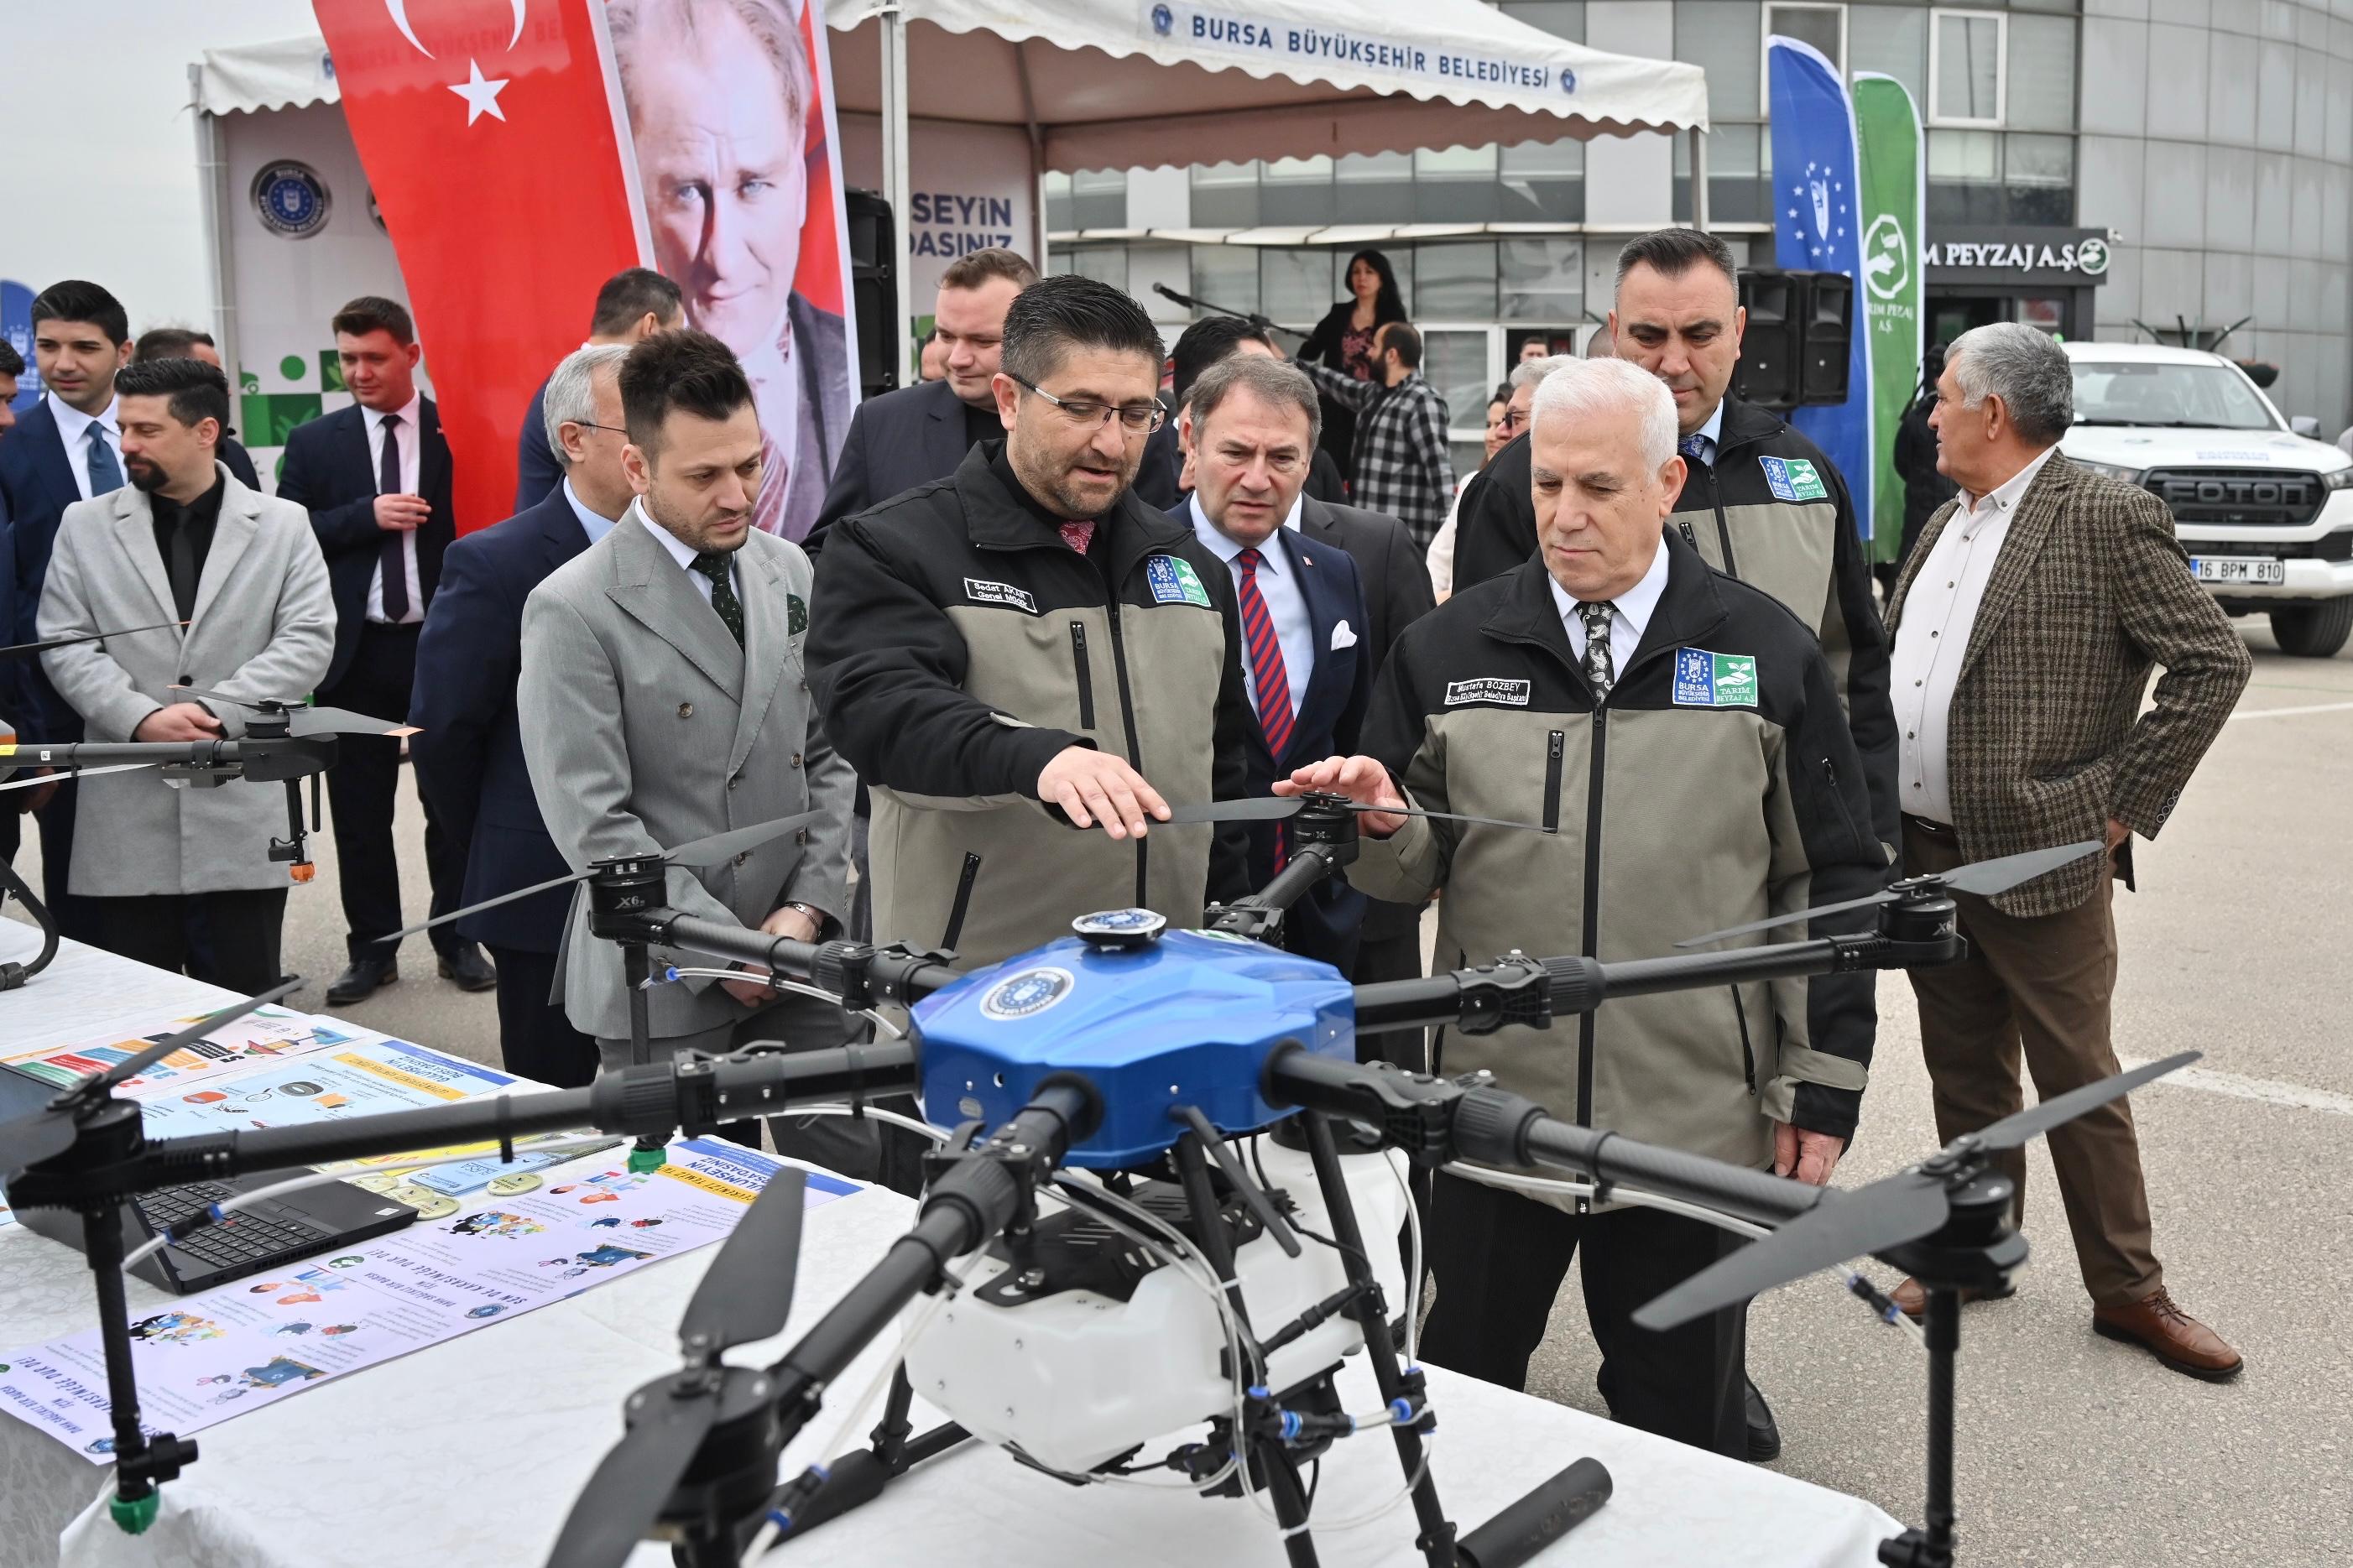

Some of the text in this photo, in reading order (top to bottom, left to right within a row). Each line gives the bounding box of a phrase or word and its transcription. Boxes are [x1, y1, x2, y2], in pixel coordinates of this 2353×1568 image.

[1192, 15, 1549, 89] BURSA BÜYÜKŞEHİR BELEDİYESİ
[1945, 243, 2035, 272] PEYZAJ
[2036, 243, 2079, 272] A.Ş.
[2199, 562, 2281, 579] 16 BPM 810
[974, 583, 1025, 600] Sedat AKAR
[978, 591, 1003, 600] Genel
[1458, 681, 1521, 692] Mustafa BOZBEY
[1678, 682, 1709, 691] BURSA
[685, 1161, 764, 1190] ÜLÜMSEYİN
[697, 1156, 770, 1184] RSA'DASINIZ
[387, 1257, 415, 1268] DUR
[481, 1289, 502, 1298] DE
[499, 1295, 528, 1305] SEN
[33, 1364, 63, 1380] DUR
[0, 1385, 27, 1402] BURSA
[59, 1378, 111, 1412] ARASİNEĞE
[60, 1420, 83, 1435] DAHA
